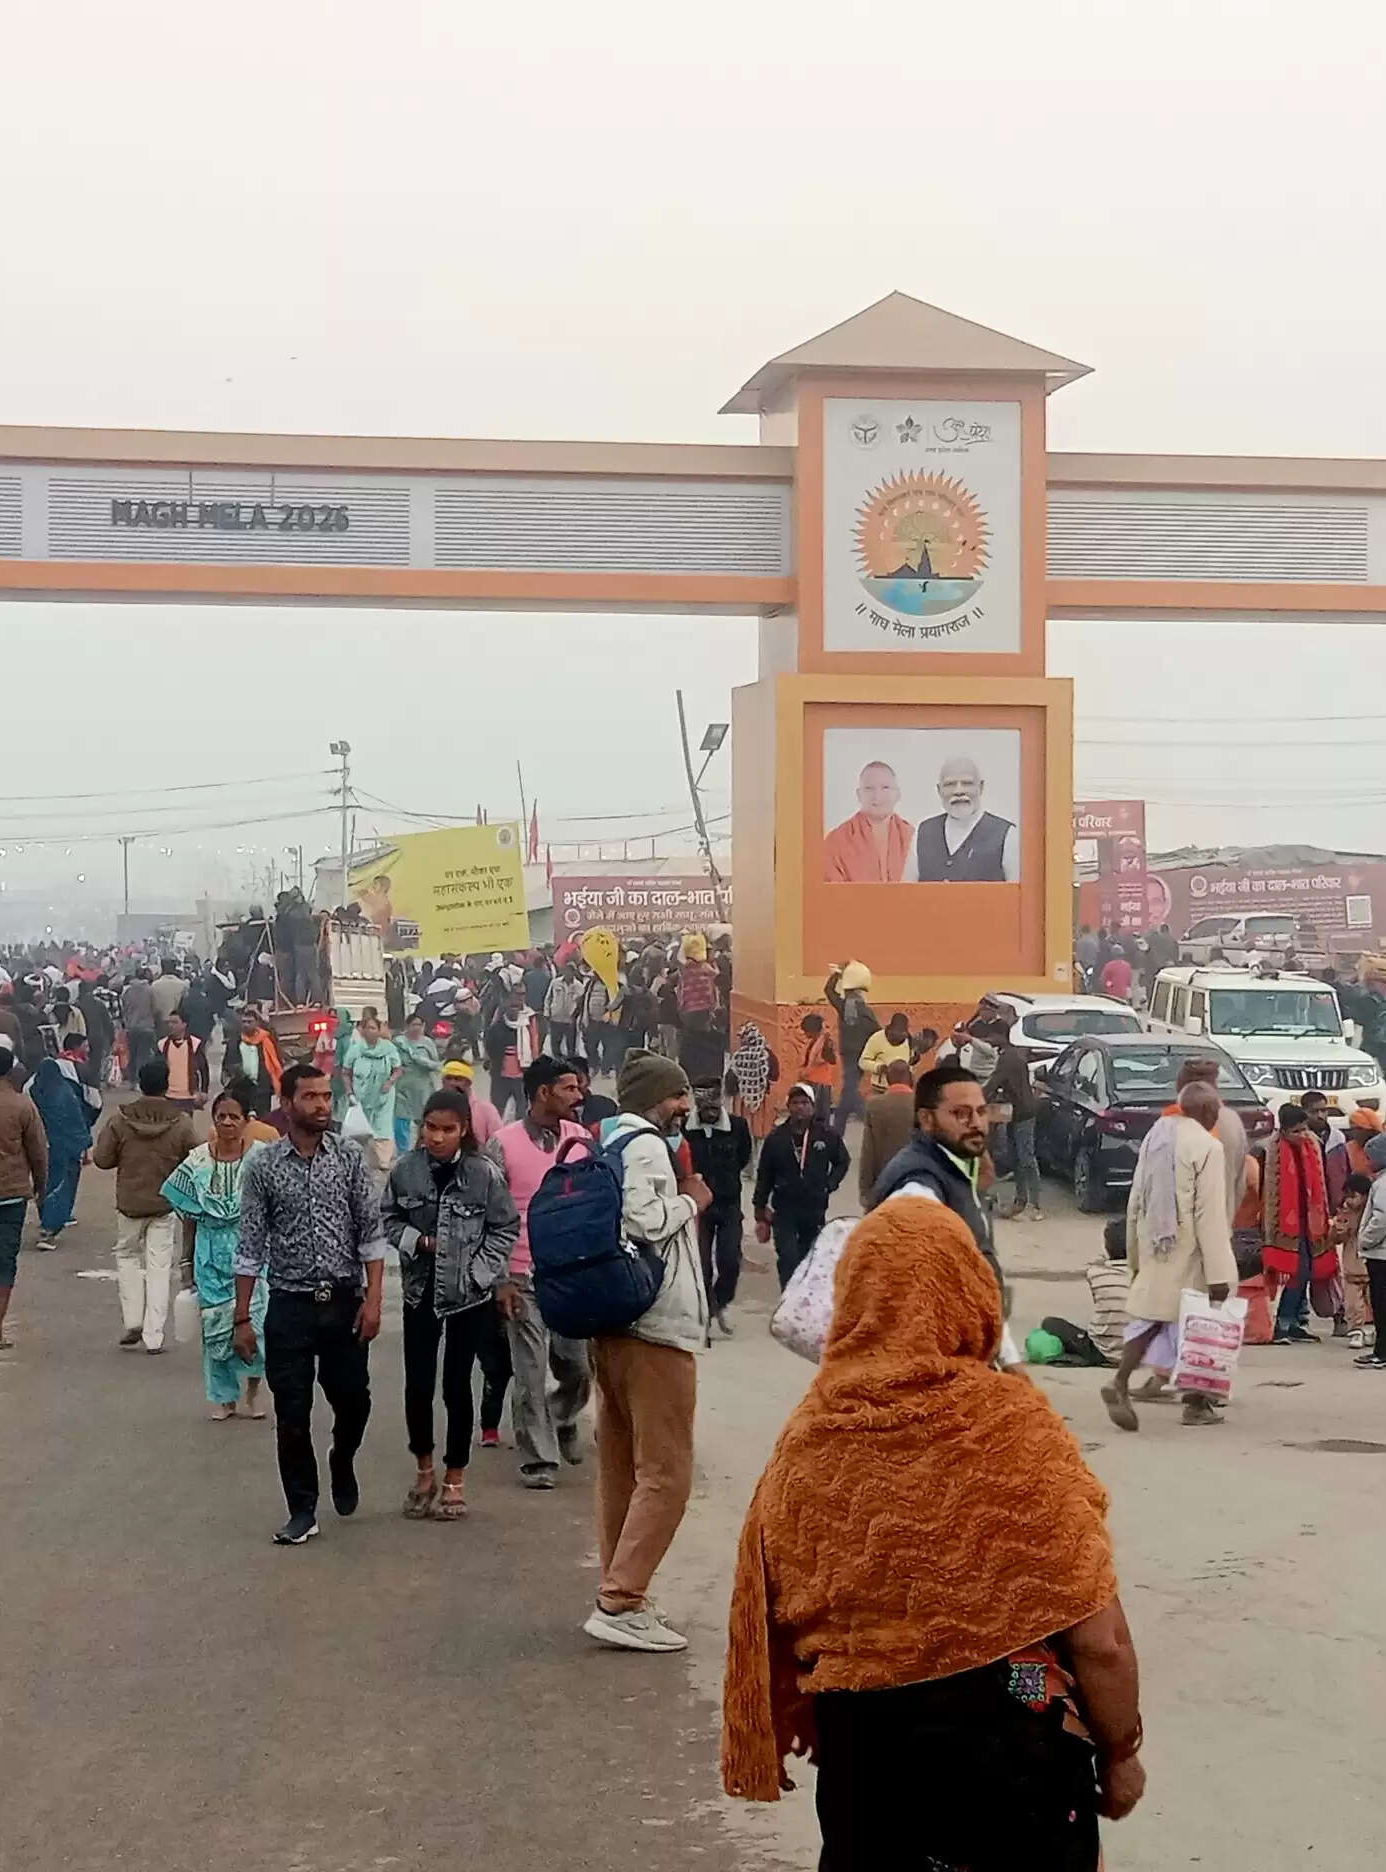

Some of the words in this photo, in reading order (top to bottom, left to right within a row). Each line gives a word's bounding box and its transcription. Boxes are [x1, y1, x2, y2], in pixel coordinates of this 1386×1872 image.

[112, 500, 188, 528] MAGH
[199, 503, 269, 530] MELA
[278, 504, 349, 531] 2026
[869, 609, 890, 631] माघ
[892, 619, 915, 638] मेला
[919, 614, 971, 639] प्रयागराज
[564, 886, 603, 909] भईया
[607, 886, 625, 906] जी
[628, 889, 648, 905] का
[651, 890, 715, 906] दाल-भात
